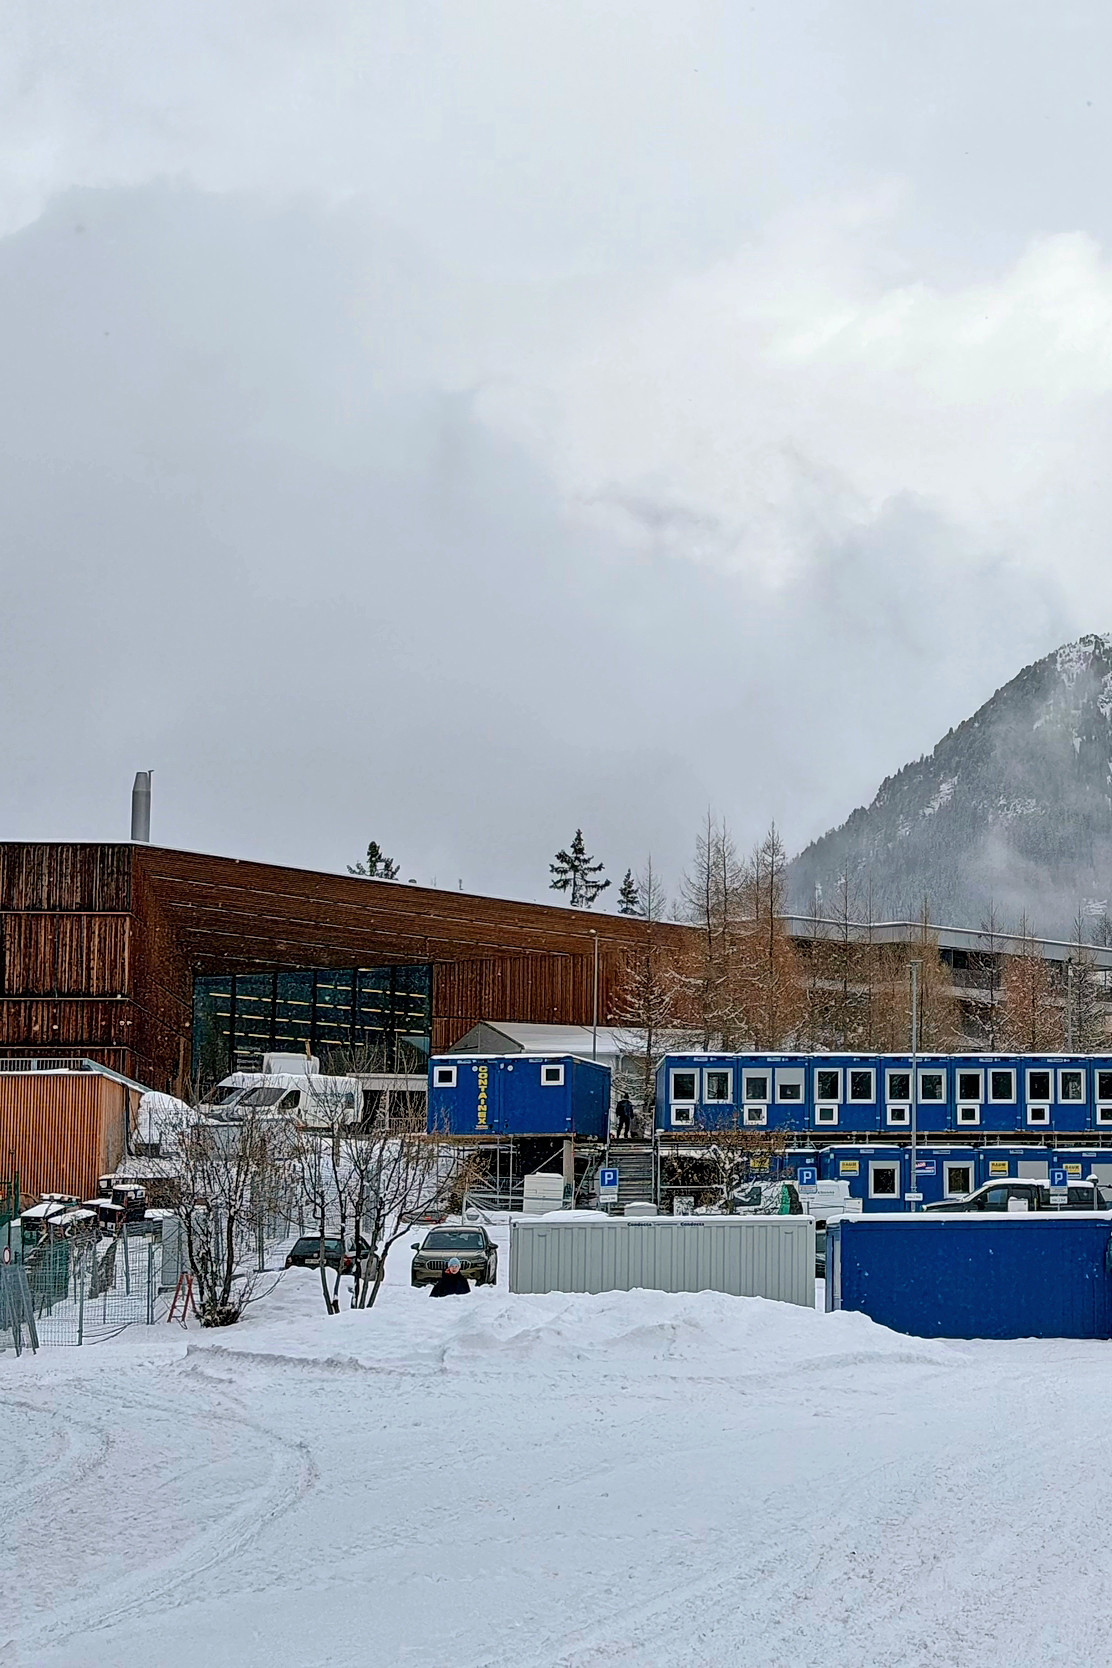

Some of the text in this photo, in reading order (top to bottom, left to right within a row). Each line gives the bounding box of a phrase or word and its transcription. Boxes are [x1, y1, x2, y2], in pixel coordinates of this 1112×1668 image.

[478, 1065, 488, 1125] CONTAINEX
[604, 1171, 614, 1185] P
[802, 1171, 812, 1184] P
[1054, 1172, 1063, 1185] P
